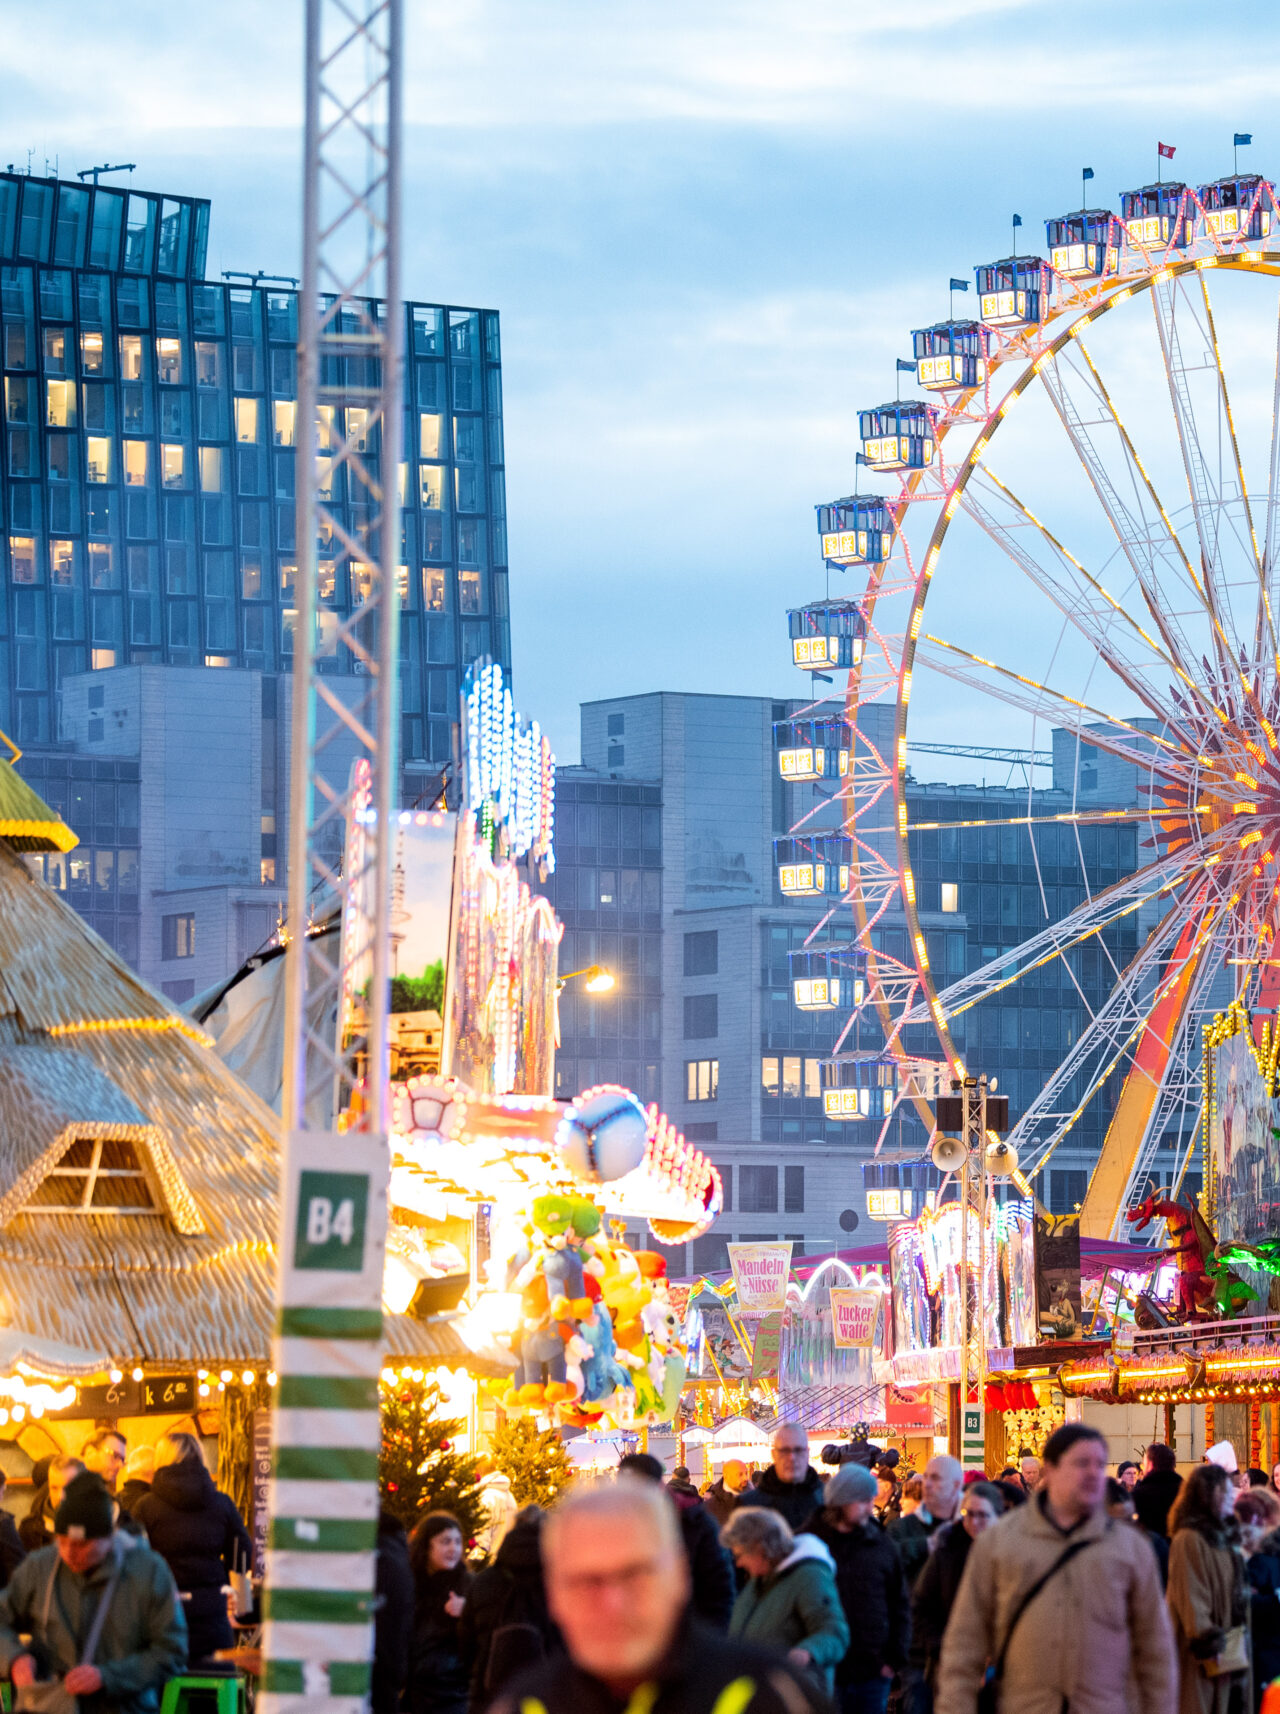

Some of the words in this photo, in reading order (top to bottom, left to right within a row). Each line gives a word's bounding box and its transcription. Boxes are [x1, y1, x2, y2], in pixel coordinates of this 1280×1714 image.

[307, 1197, 354, 1244] B4
[738, 1258, 784, 1276] Mandeln
[838, 1304, 874, 1321] Zucker-
[840, 1320, 869, 1339] watte
[967, 1418, 978, 1428] B3
